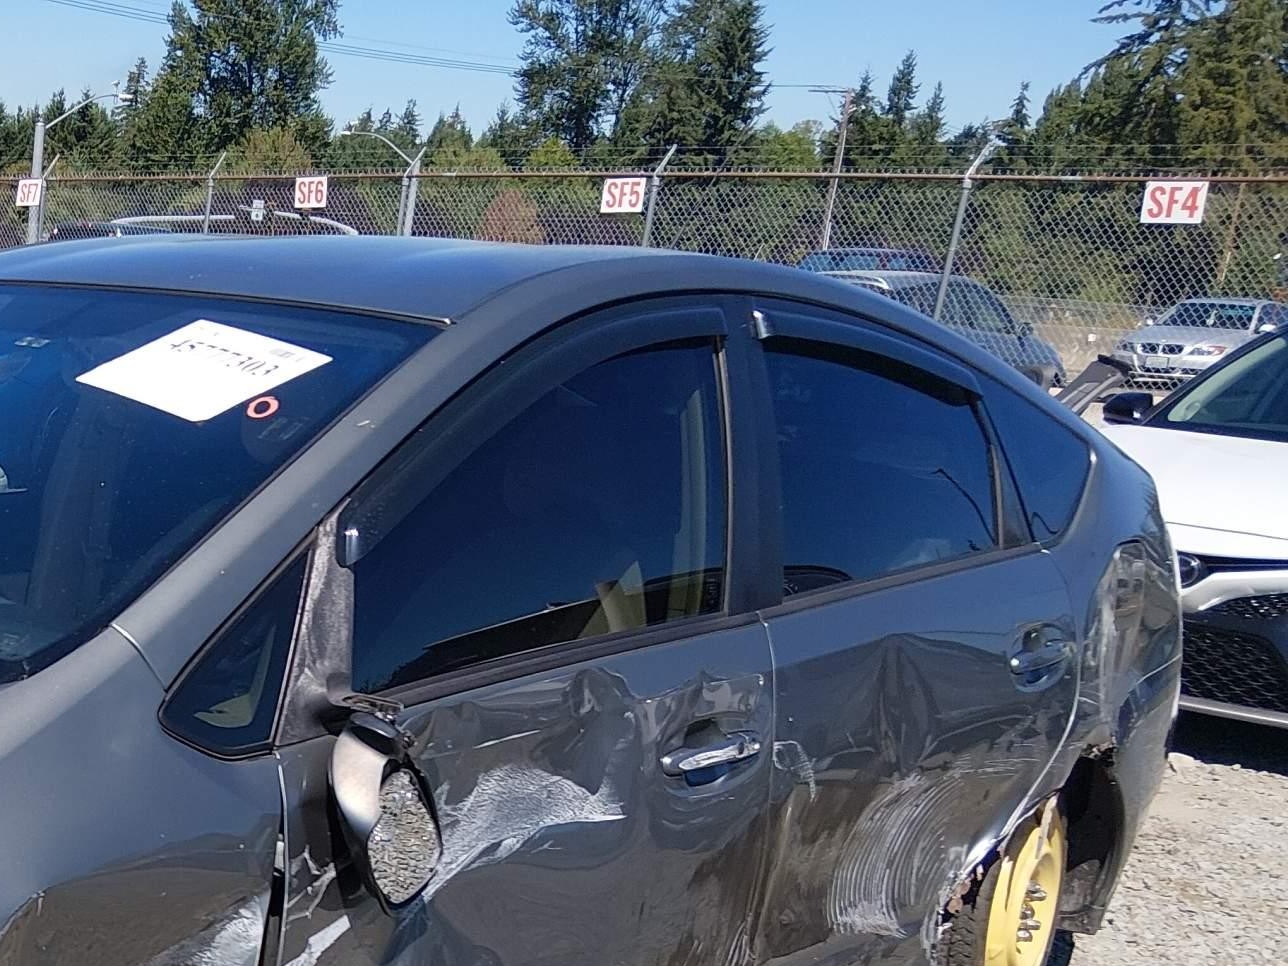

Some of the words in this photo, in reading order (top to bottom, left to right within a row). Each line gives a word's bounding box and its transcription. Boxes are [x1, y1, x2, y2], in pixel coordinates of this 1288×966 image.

[20, 183, 39, 203] SF7
[297, 180, 324, 204] SF6
[605, 181, 641, 208] SF5
[1146, 185, 1199, 219] SF4
